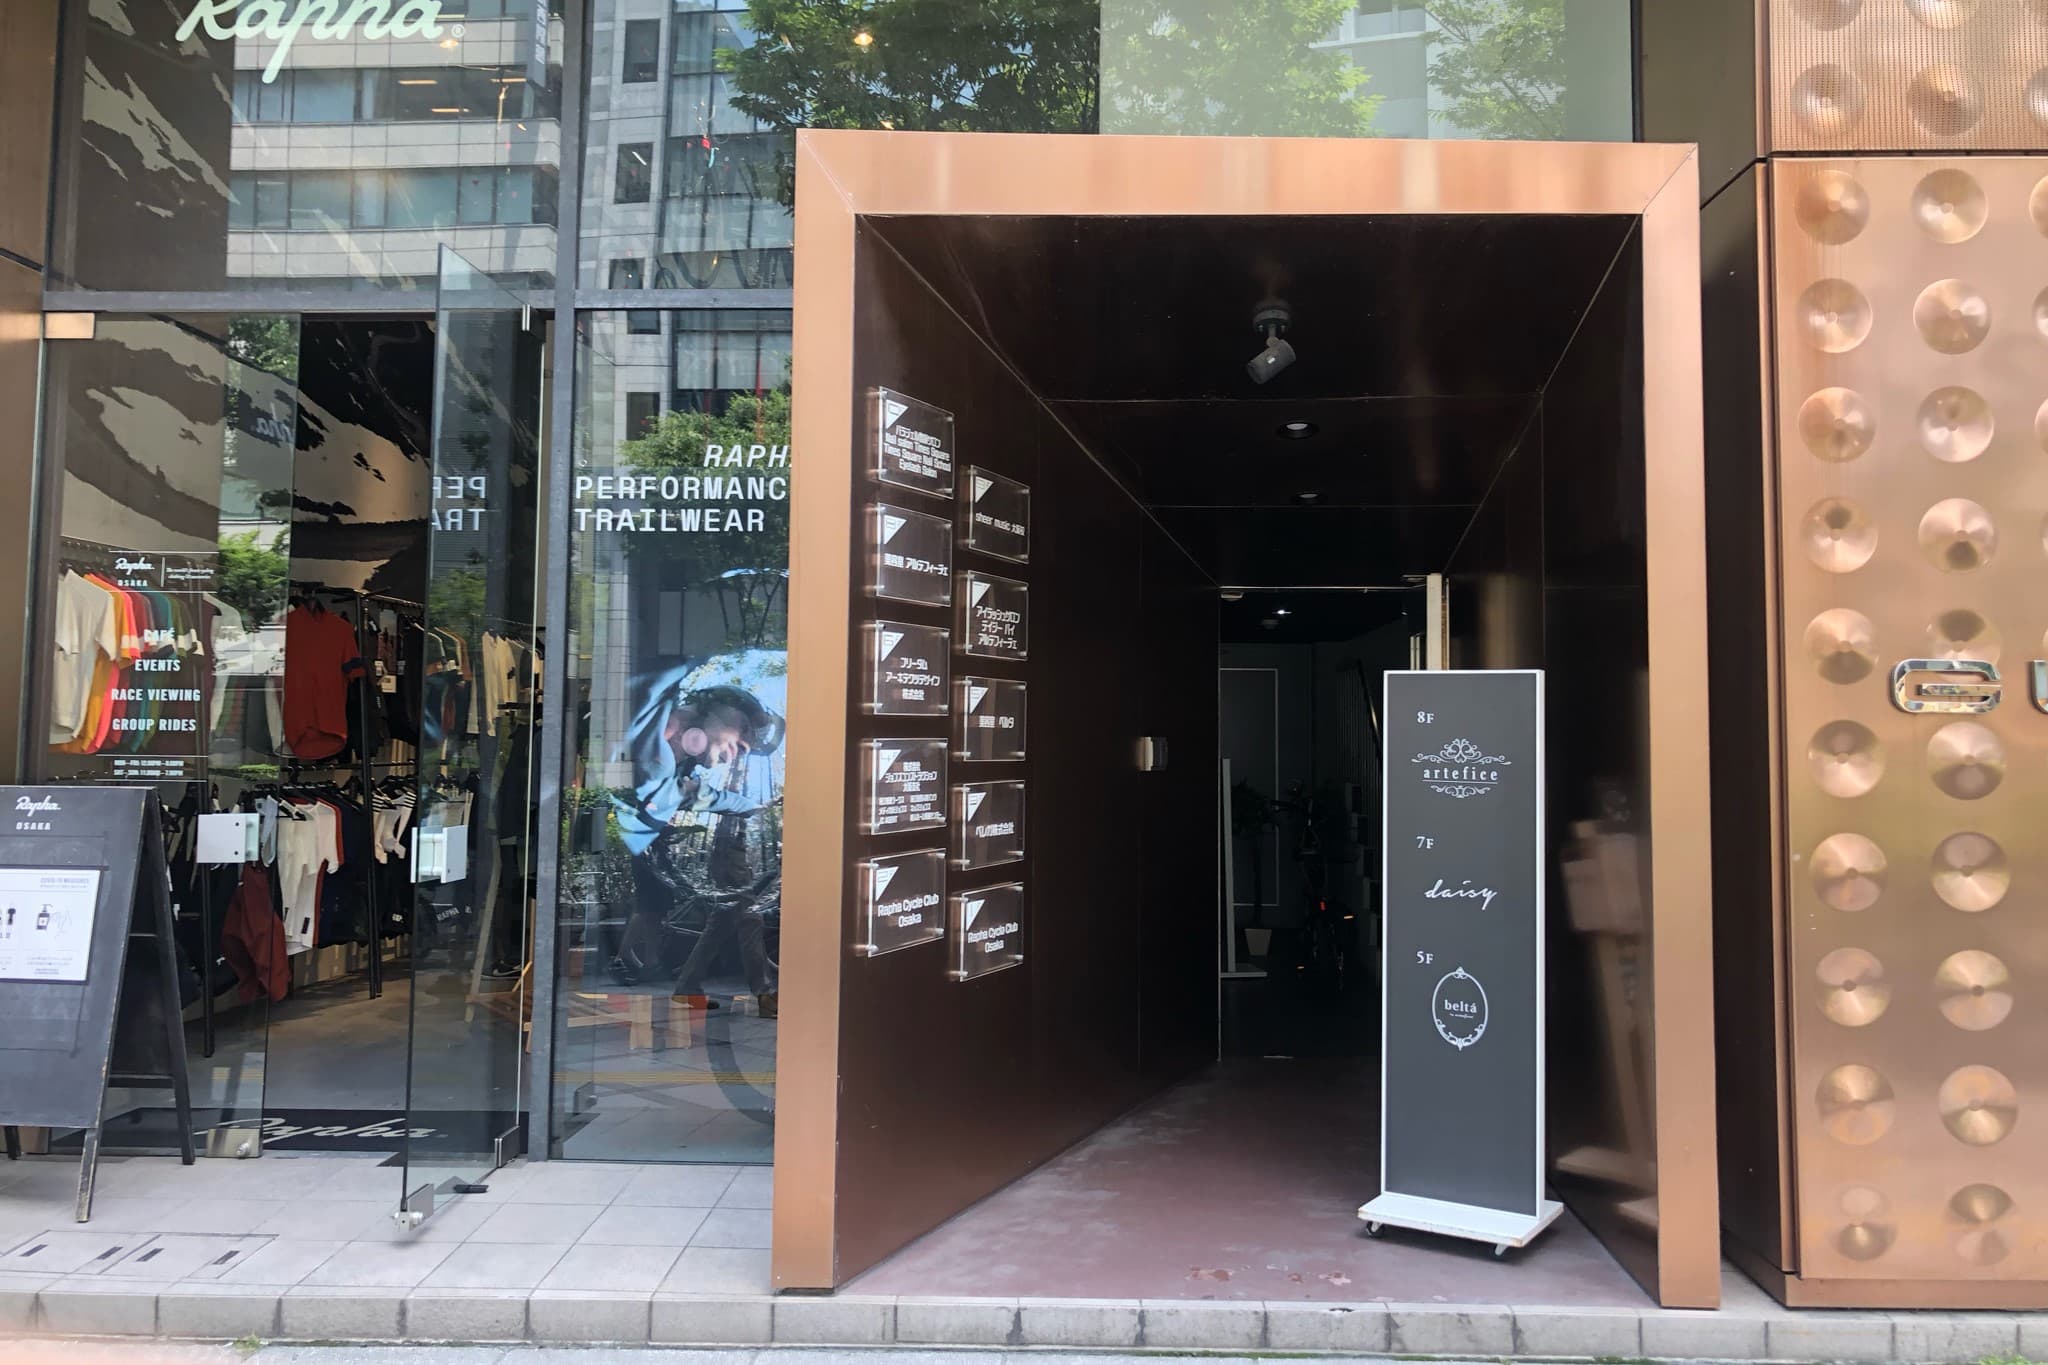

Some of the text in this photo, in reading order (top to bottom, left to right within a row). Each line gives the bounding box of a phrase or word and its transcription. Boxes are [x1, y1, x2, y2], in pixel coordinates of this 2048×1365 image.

[703, 444, 792, 468] RAPH
[576, 476, 787, 501] PERFORMANC
[575, 508, 765, 532] TRAILWEAR
[115, 557, 155, 575] Rapha
[117, 579, 148, 587] OSAKA
[135, 659, 181, 671] EVENTS
[111, 688, 201, 701] RACE VIEWING
[112, 718, 197, 731] GROUP RIDES
[1417, 711, 1434, 723] 8F
[1423, 766, 1498, 781] artefice
[15, 795, 61, 817] Rapha
[15, 821, 51, 831] OSAKA
[1416, 836, 1434, 849] 7F
[1424, 879, 1498, 911] daisy
[877, 893, 940, 917] Rapha Cycle Club
[898, 913, 922, 928] Osaka
[968, 921, 1019, 943] Rapha Cycle Club
[984, 940, 1004, 953] Osaka
[1416, 951, 1434, 964] 5F
[1444, 999, 1478, 1014] beltá
